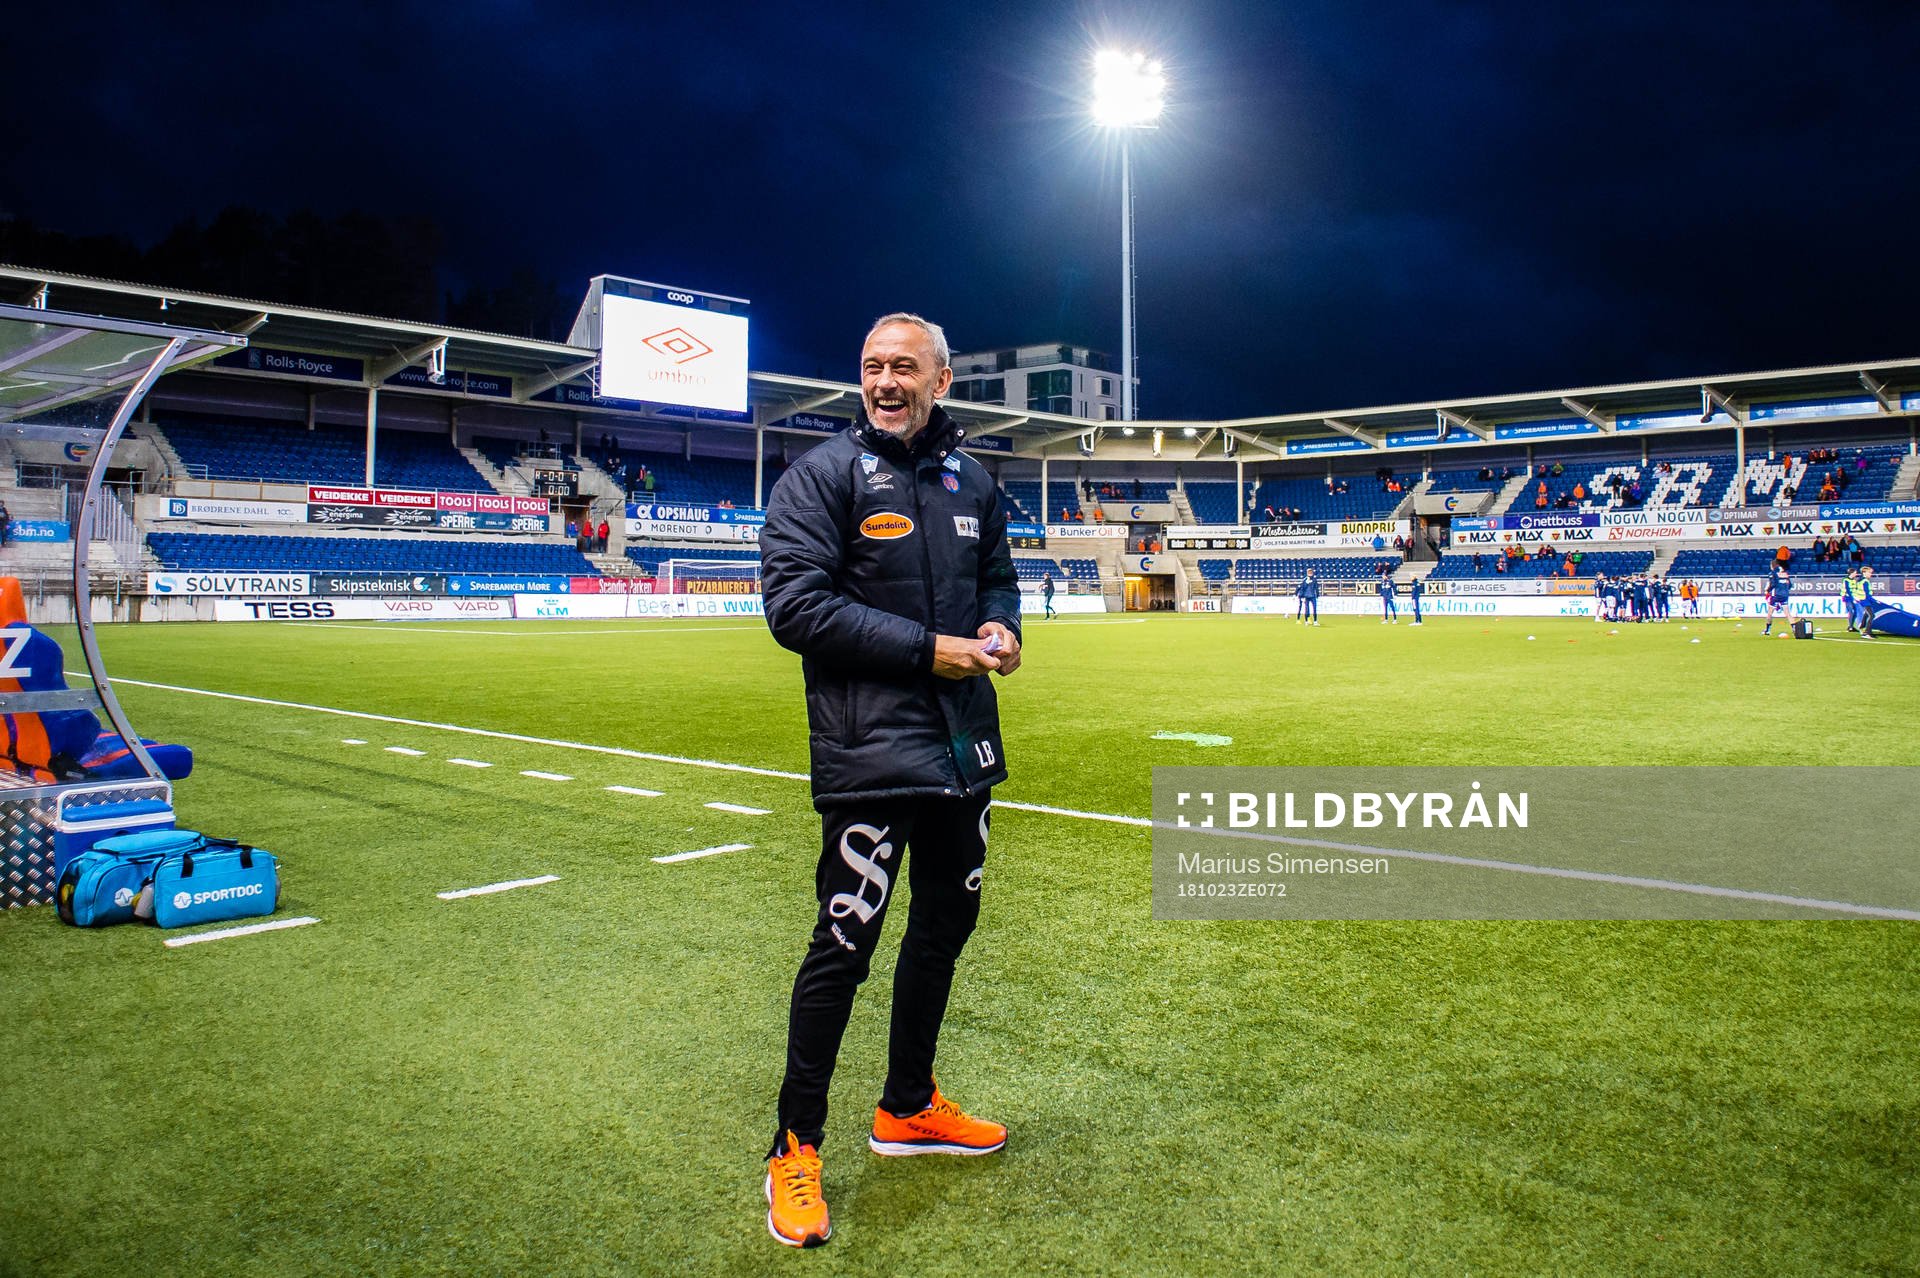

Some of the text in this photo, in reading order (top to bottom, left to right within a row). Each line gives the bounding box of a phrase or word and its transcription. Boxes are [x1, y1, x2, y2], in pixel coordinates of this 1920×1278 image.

[667, 291, 694, 305] coop
[265, 354, 333, 373] Rolls-Royce
[795, 416, 834, 430] Rolls-Royce
[314, 490, 369, 502] VEIDEKKE
[380, 494, 431, 504] VEIDEKKE
[439, 496, 472, 507] TOOLS
[478, 498, 509, 509] TOOLS
[516, 501, 546, 511] TOOLS
[191, 505, 242, 514] BRØDRENE
[243, 507, 269, 515] DAHL
[329, 510, 364, 519] energima
[657, 506, 710, 521] OPSHAUG
[1723, 511, 1758, 520] OPTIMAR
[1781, 509, 1817, 518] OPTIMAR
[1834, 507, 1894, 517] SPAREBANKEN
[399, 513, 431, 522] energima
[1533, 516, 1583, 527] nettbuss
[1603, 513, 1648, 525] NOGVA
[1657, 511, 1704, 523] NOGVA
[12, 525, 55, 537] sbm.no
[651, 523, 698, 535] MØRENOT
[865, 521, 908, 532] Sundolitt
[1060, 526, 1113, 536] Bunker Oil
[1341, 521, 1396, 534] BUNNPRIS
[1720, 524, 1753, 537] MAX
[1778, 522, 1813, 535] MAX
[1837, 520, 1874, 534] MAX
[1469, 531, 1496, 543] MAX
[1515, 530, 1544, 542] MAX
[1564, 528, 1593, 540] MAX
[330, 579, 411, 594] Skipsteknisk
[469, 581, 551, 591] SPAREBANKEN MØRE
[599, 578, 652, 593] Scandic Parken
[686, 580, 751, 594] PIZZABAKEREN
[1357, 582, 1374, 594] XL
[1429, 582, 1447, 594] XL
[1463, 583, 1507, 592] BRAGES
[244, 601, 335, 619] TESS
[384, 601, 433, 611] VARD
[454, 601, 499, 611] VARD
[536, 607, 569, 616] KLM
[697, 596, 717, 617] på
[1192, 601, 1216, 611] ACEL
[1560, 607, 1589, 615] KLM
[973, 740, 997, 768] LB
[193, 883, 263, 905] SPORTDOC
